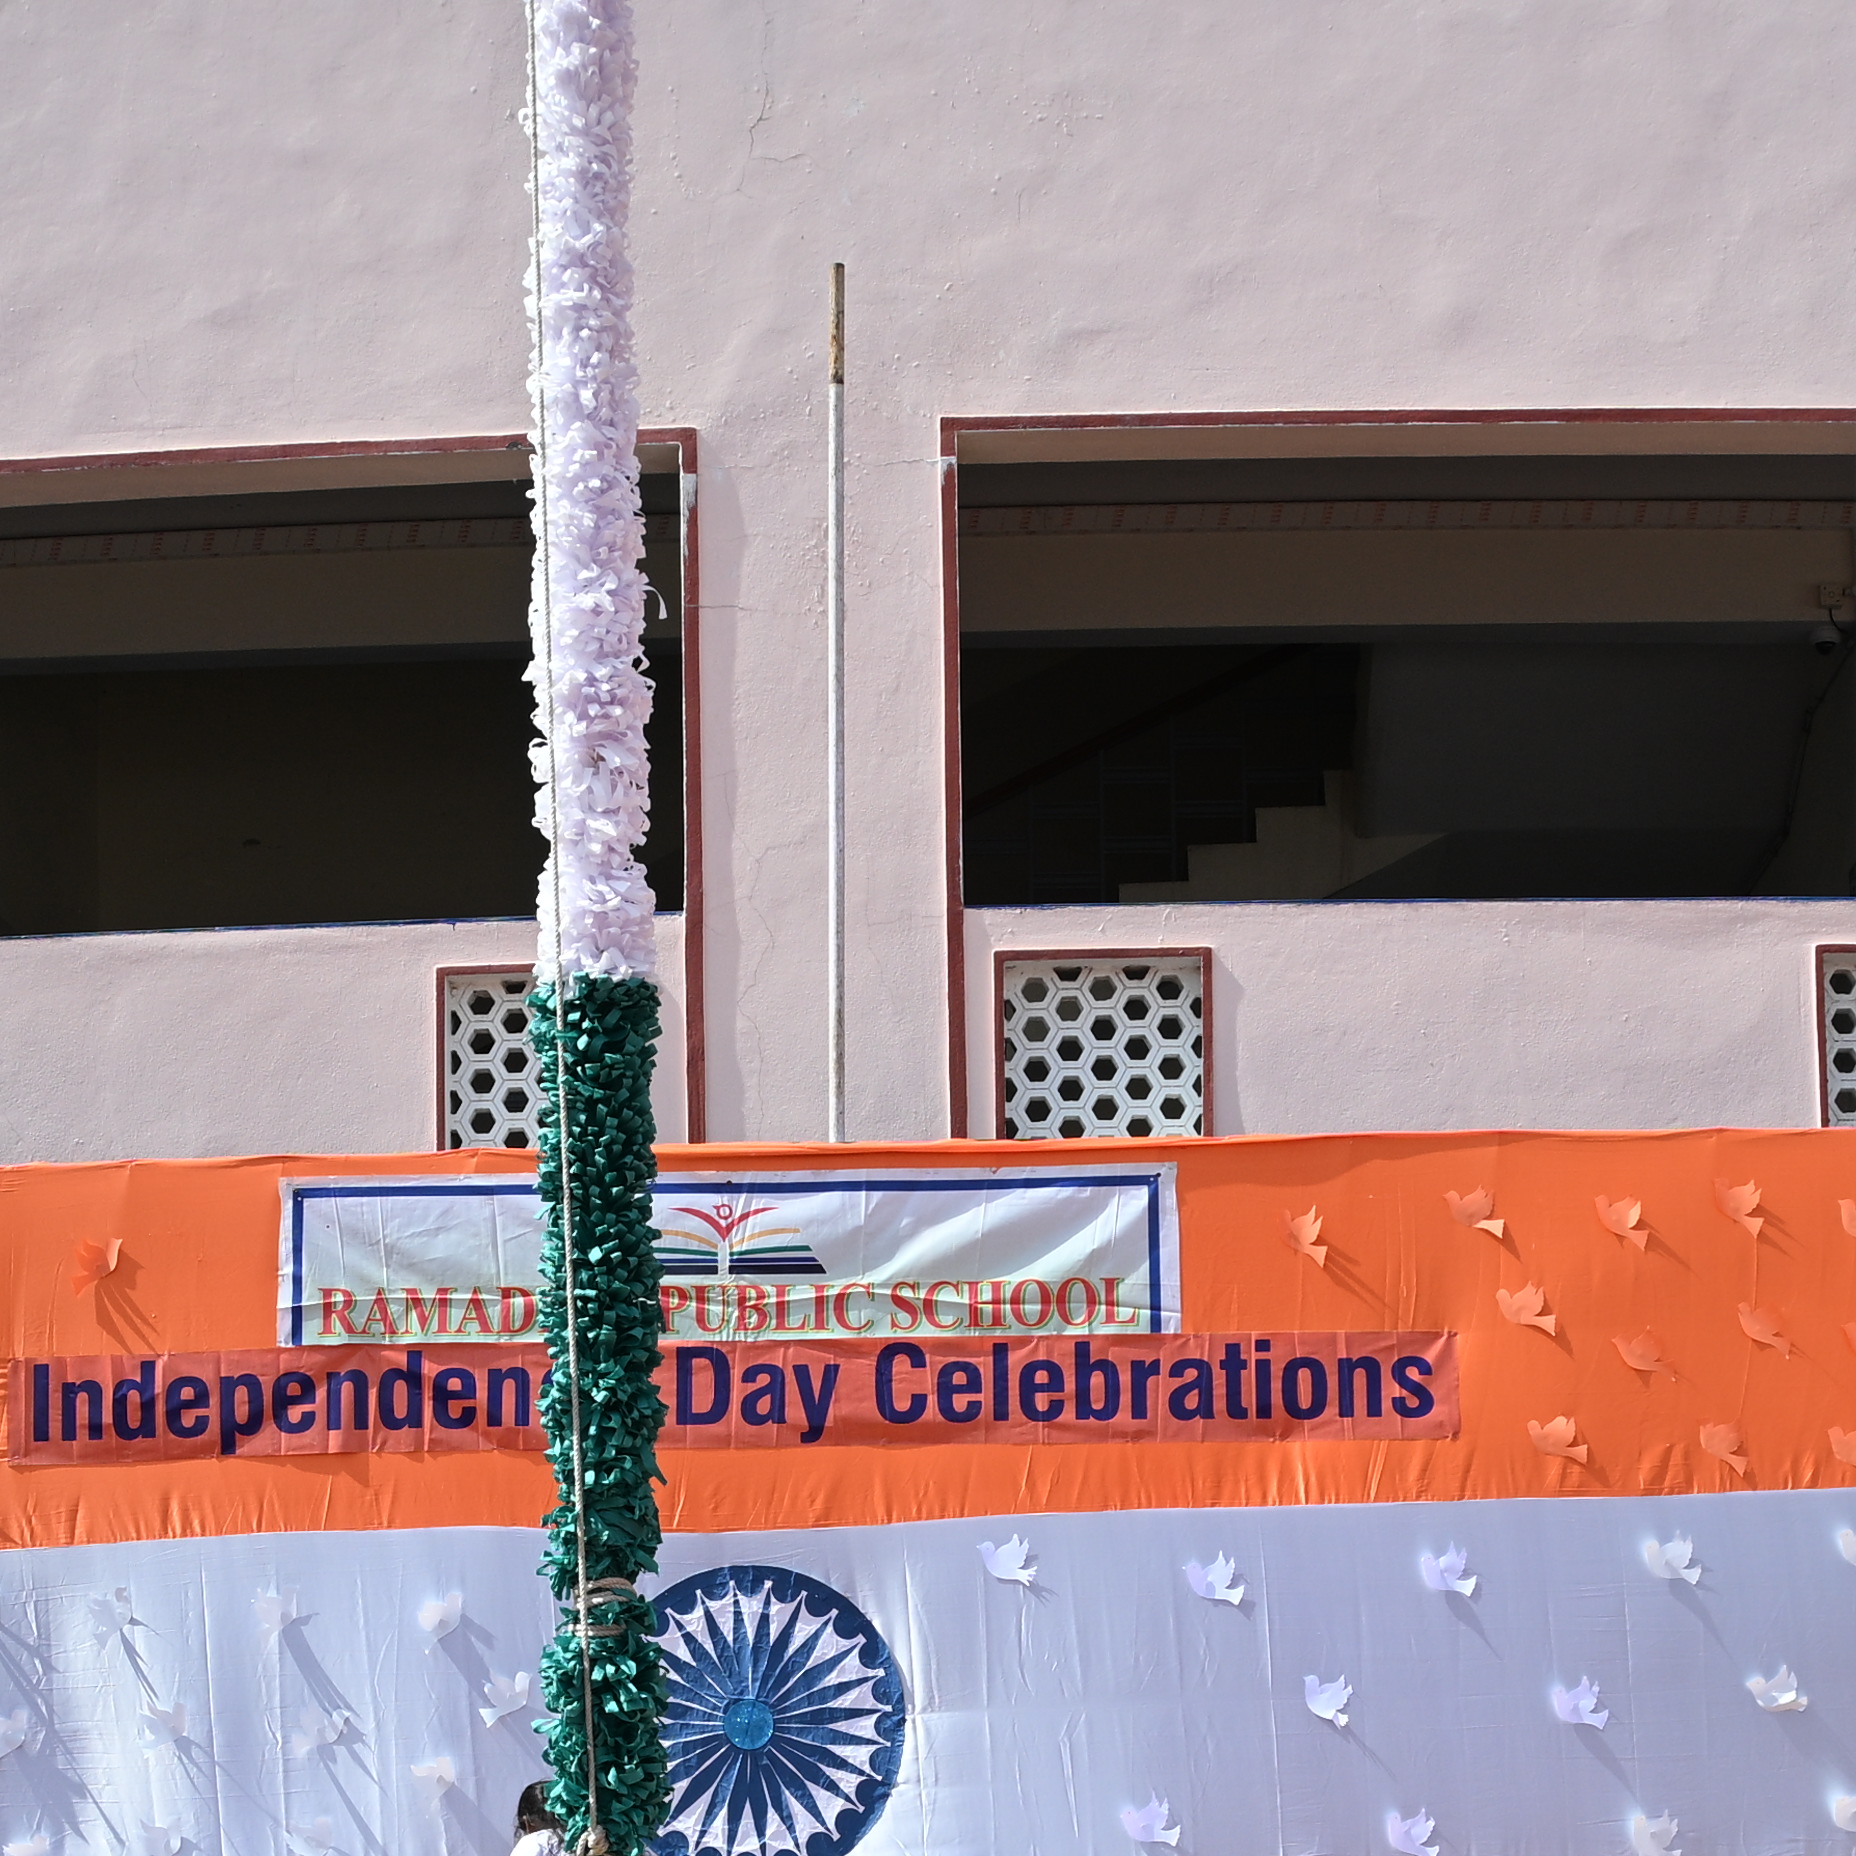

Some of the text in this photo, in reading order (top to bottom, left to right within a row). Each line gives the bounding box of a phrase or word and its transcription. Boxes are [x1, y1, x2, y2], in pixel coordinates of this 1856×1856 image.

[317, 1277, 1141, 1338] RAMAD PUBLIC SCHOOL
[33, 1339, 1435, 1455] Independen Day Celebrations
